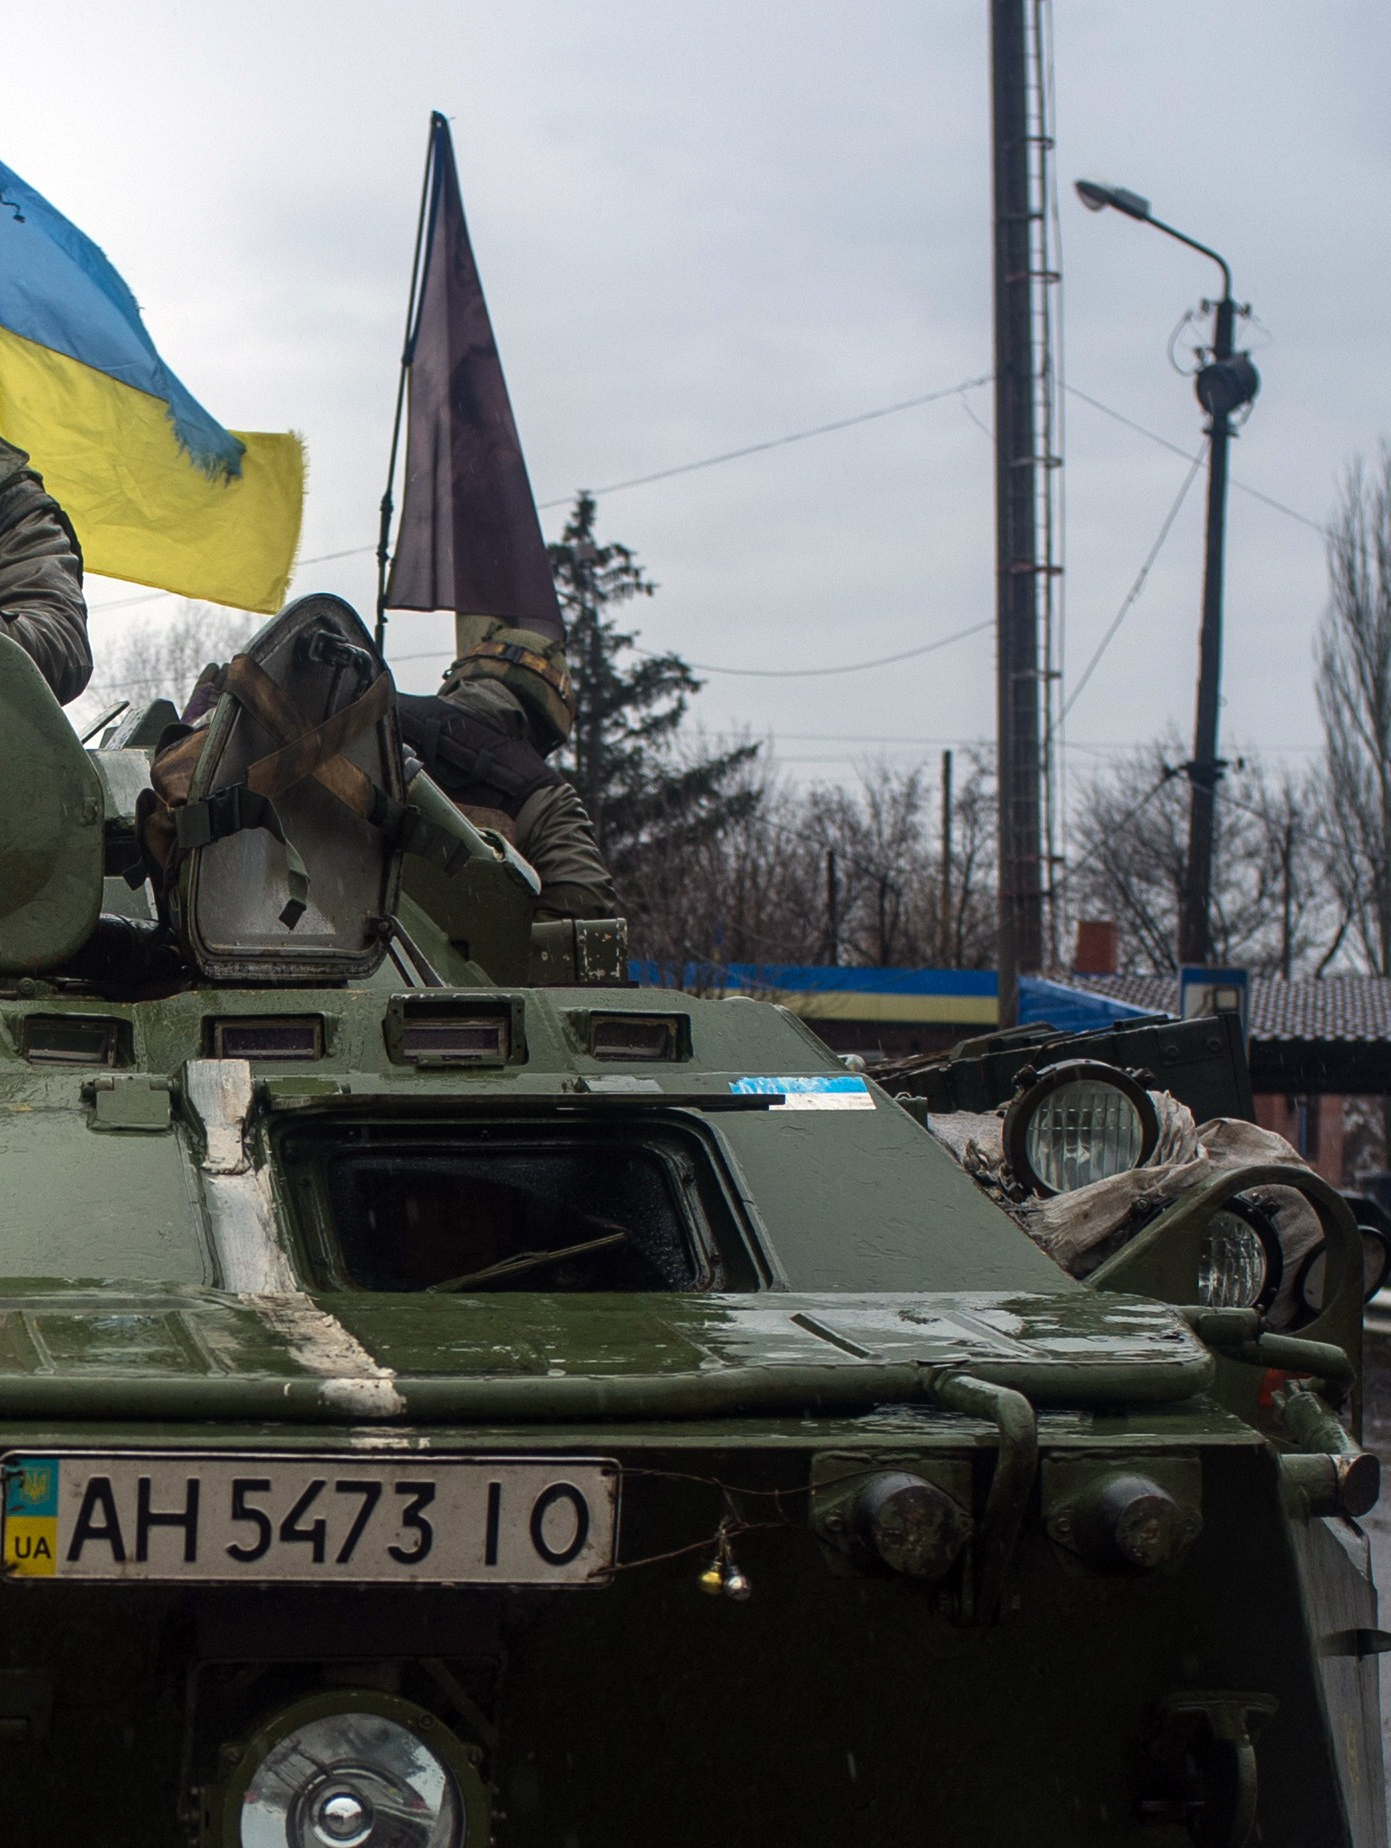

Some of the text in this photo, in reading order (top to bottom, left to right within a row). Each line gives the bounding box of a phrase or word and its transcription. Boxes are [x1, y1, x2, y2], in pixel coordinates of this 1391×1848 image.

[14, 1536, 51, 1559] UA
[66, 1476, 590, 1567] AH 5473 IO
